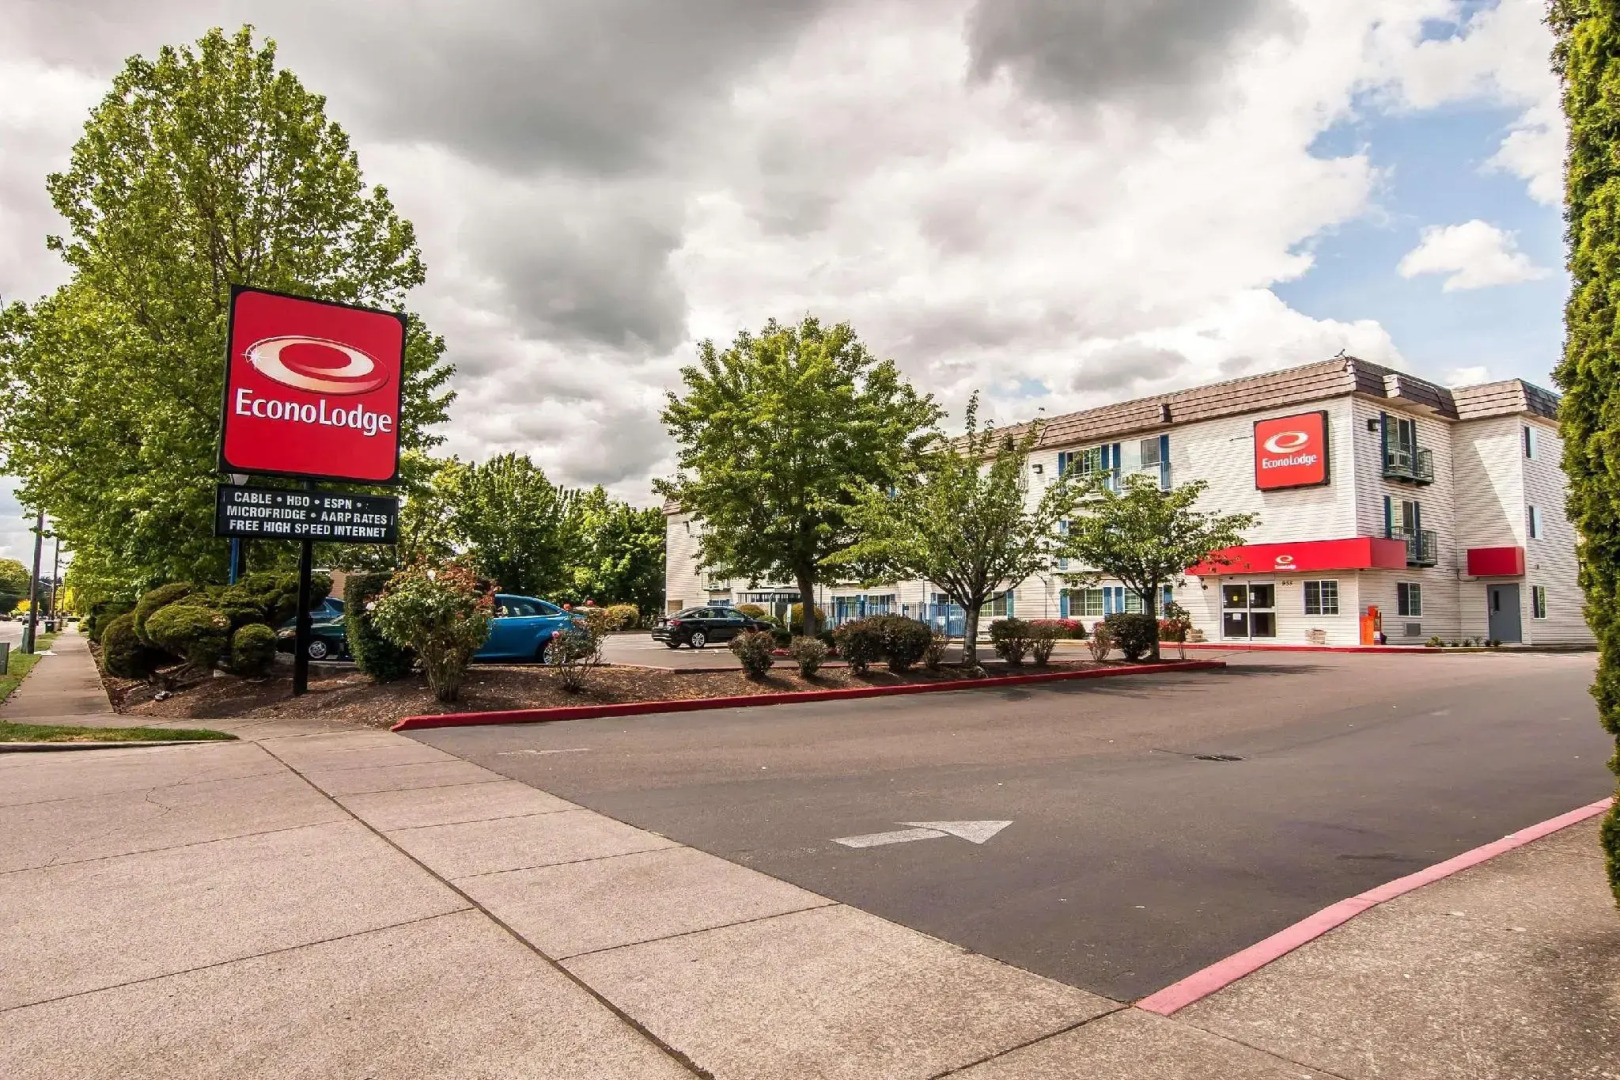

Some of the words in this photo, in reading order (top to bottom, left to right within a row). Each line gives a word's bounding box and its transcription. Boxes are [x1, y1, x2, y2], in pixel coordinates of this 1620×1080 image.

[235, 387, 393, 437] EconoLodge
[1262, 453, 1317, 469] EconoLodge
[234, 491, 272, 504] CABLE
[286, 495, 310, 507] HBO
[323, 497, 352, 510] ESPN
[226, 505, 307, 520] MICROFRIDGE
[320, 511, 352, 523] AARP
[353, 513, 388, 525] RATES
[229, 519, 259, 531] FREE
[263, 521, 291, 533] HIGH
[294, 523, 331, 535] SPEED
[334, 525, 387, 538] INTERNET
